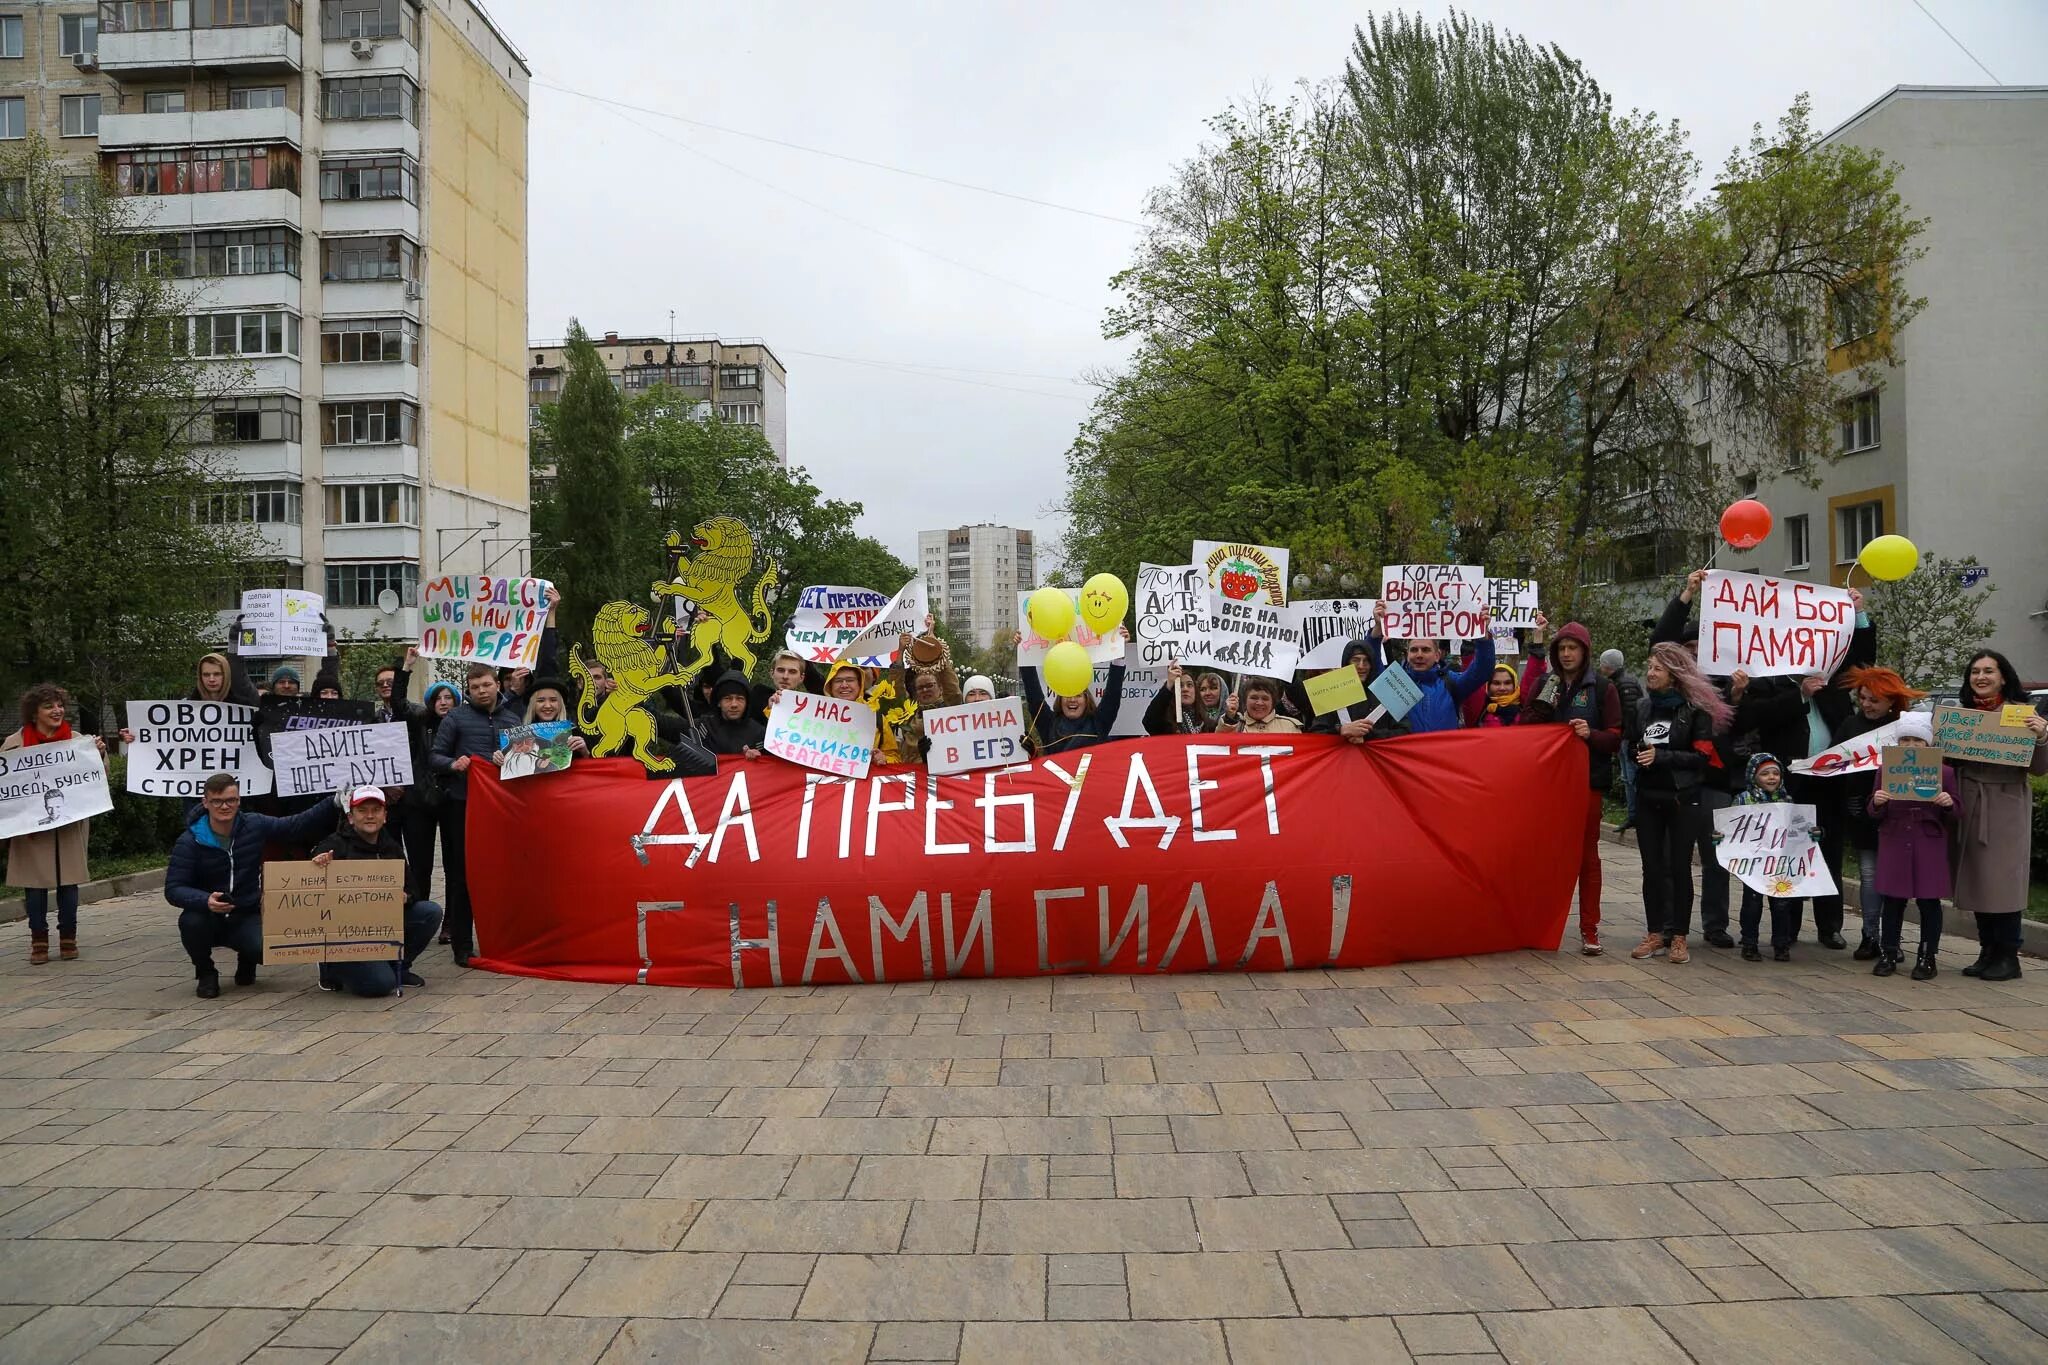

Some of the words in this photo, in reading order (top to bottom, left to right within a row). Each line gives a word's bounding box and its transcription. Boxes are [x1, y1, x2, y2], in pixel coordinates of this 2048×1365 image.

[1402, 565, 1463, 582] КОГДА
[425, 576, 470, 602] МЫ
[477, 576, 551, 609] ЗДЕСЬ
[1386, 581, 1482, 604] ВЫРАСТУ,
[1488, 578, 1530, 593] МЕНЯ
[247, 593, 272, 601] сделай
[800, 587, 828, 609] НЕТ
[827, 592, 892, 609] ПРЕКРАС
[1402, 601, 1460, 612] СТАНУ
[1488, 592, 1520, 607] НЕТ
[1713, 578, 1780, 619] ДАЙ
[423, 601, 467, 624] ШОБ
[471, 604, 511, 630] НАШ
[515, 608, 548, 632] КОТ
[1222, 602, 1253, 619] ВСЕ
[1258, 610, 1279, 624] НА
[1489, 606, 1538, 623] АКАТА
[1383, 610, 1486, 639] РЭПЕРОМ
[424, 627, 541, 665] ПОДОБРЕЛ
[790, 630, 827, 643] ЧЕМ
[1093, 670, 1158, 684] КИИЛЛ,
[793, 695, 809, 714] У
[815, 701, 852, 723] НАС
[930, 708, 1018, 735] ИСТИНА
[1645, 726, 1669, 737] NERF
[139, 728, 152, 743] В
[157, 727, 256, 746] ПОМОЩЬ
[304, 728, 375, 761] ДАЙТЕ
[774, 727, 870, 763] КОМИКОВ
[14, 749, 76, 771] ДУДЕЛИ
[155, 748, 240, 771] ХРЕН
[768, 740, 860, 776] ХВАТАЕТ
[946, 747, 960, 764] В
[973, 737, 1015, 760] ЕГЭ
[1902, 749, 1916, 765] Я
[54, 770, 101, 789] БУДЕМ
[141, 778, 155, 794] С
[290, 762, 338, 794] ЮРЕ
[351, 756, 404, 787] ДУТЬ
[630, 770, 761, 869] ДА
[796, 744, 1294, 859] ПРЕБУДЕТ
[1729, 812, 1772, 844] НУ
[1727, 846, 1816, 878] ПОГОДКА!
[281, 877, 291, 888] У
[300, 876, 327, 887] МЕНЯ
[336, 874, 363, 884] ЕСТЬ
[278, 893, 326, 910] ЛИСТ
[337, 891, 395, 905] КАРТОНА
[320, 909, 332, 921] И
[283, 926, 326, 939] СИНЯЯ
[338, 925, 396, 939] ИЗОЛЕНТА
[728, 888, 996, 989] НАМИ
